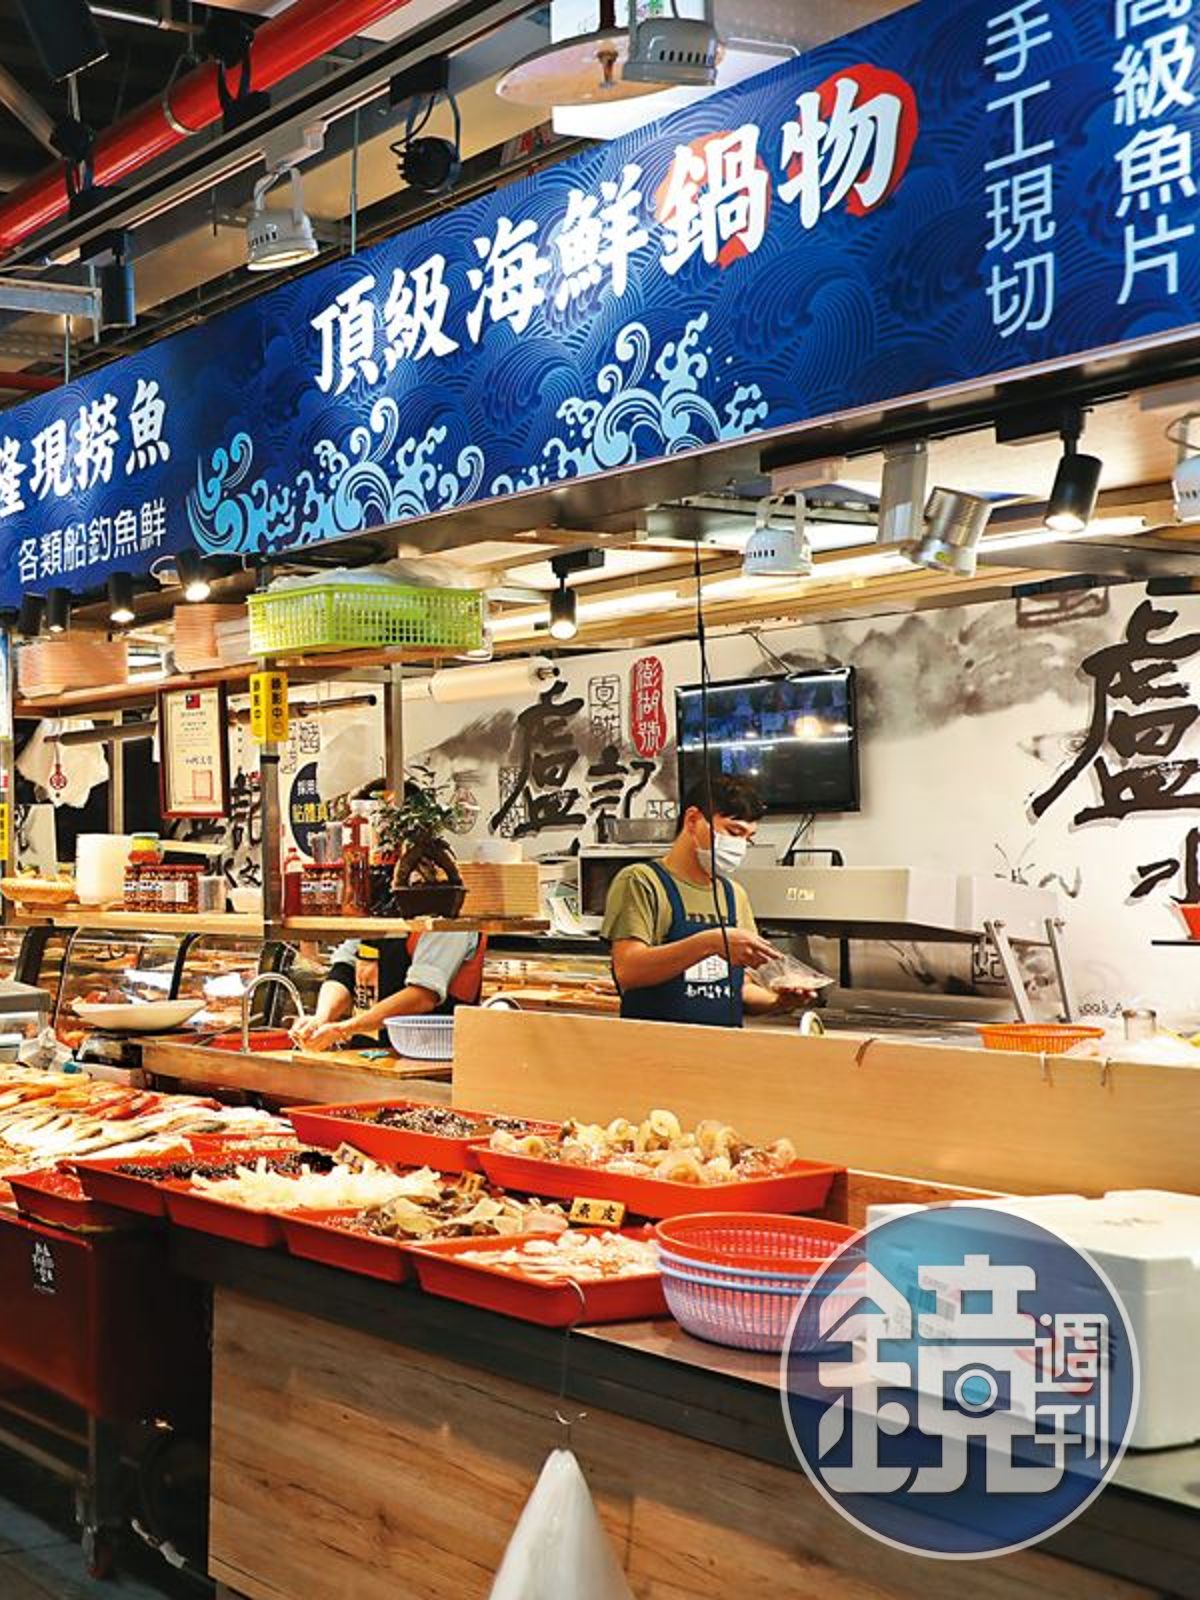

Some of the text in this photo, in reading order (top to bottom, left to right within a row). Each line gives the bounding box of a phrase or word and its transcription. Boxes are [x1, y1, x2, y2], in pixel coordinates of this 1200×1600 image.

[311, 77, 902, 397] 頂級海鮮鍋物
[984, 0, 1056, 338] 手工現切
[17, 498, 167, 584] 各類船釣魚鮮
